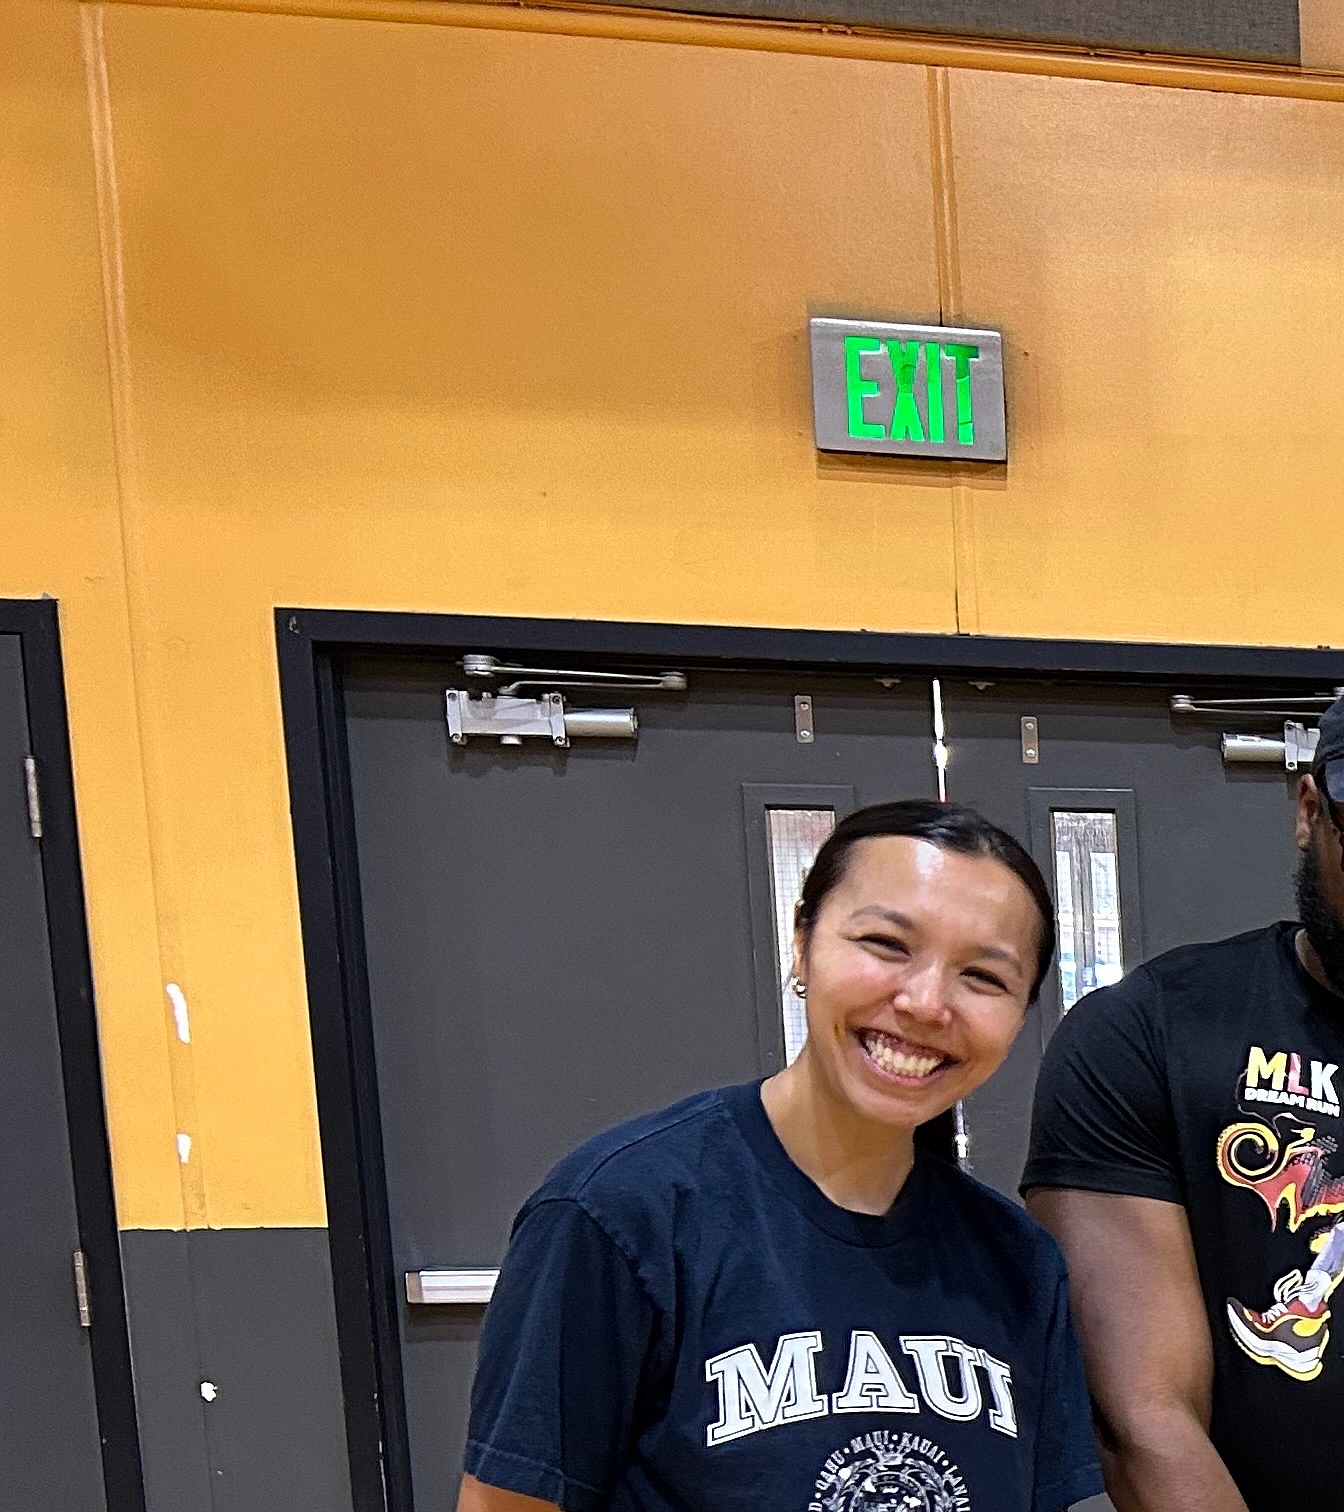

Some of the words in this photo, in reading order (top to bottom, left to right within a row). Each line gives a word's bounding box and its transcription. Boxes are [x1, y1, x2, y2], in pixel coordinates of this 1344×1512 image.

[844, 336, 980, 445] EXIT
[1244, 1087, 1305, 1108] DREAM
[1305, 1097, 1340, 1117] RUN
[1246, 1046, 1340, 1105] MLK
[706, 1330, 1018, 1447] MAUI
[815, 1449, 845, 1490] OAHU
[850, 1430, 889, 1453] MAUI
[901, 1432, 946, 1463] KAUAI
[943, 1465, 971, 1512] LANAI
